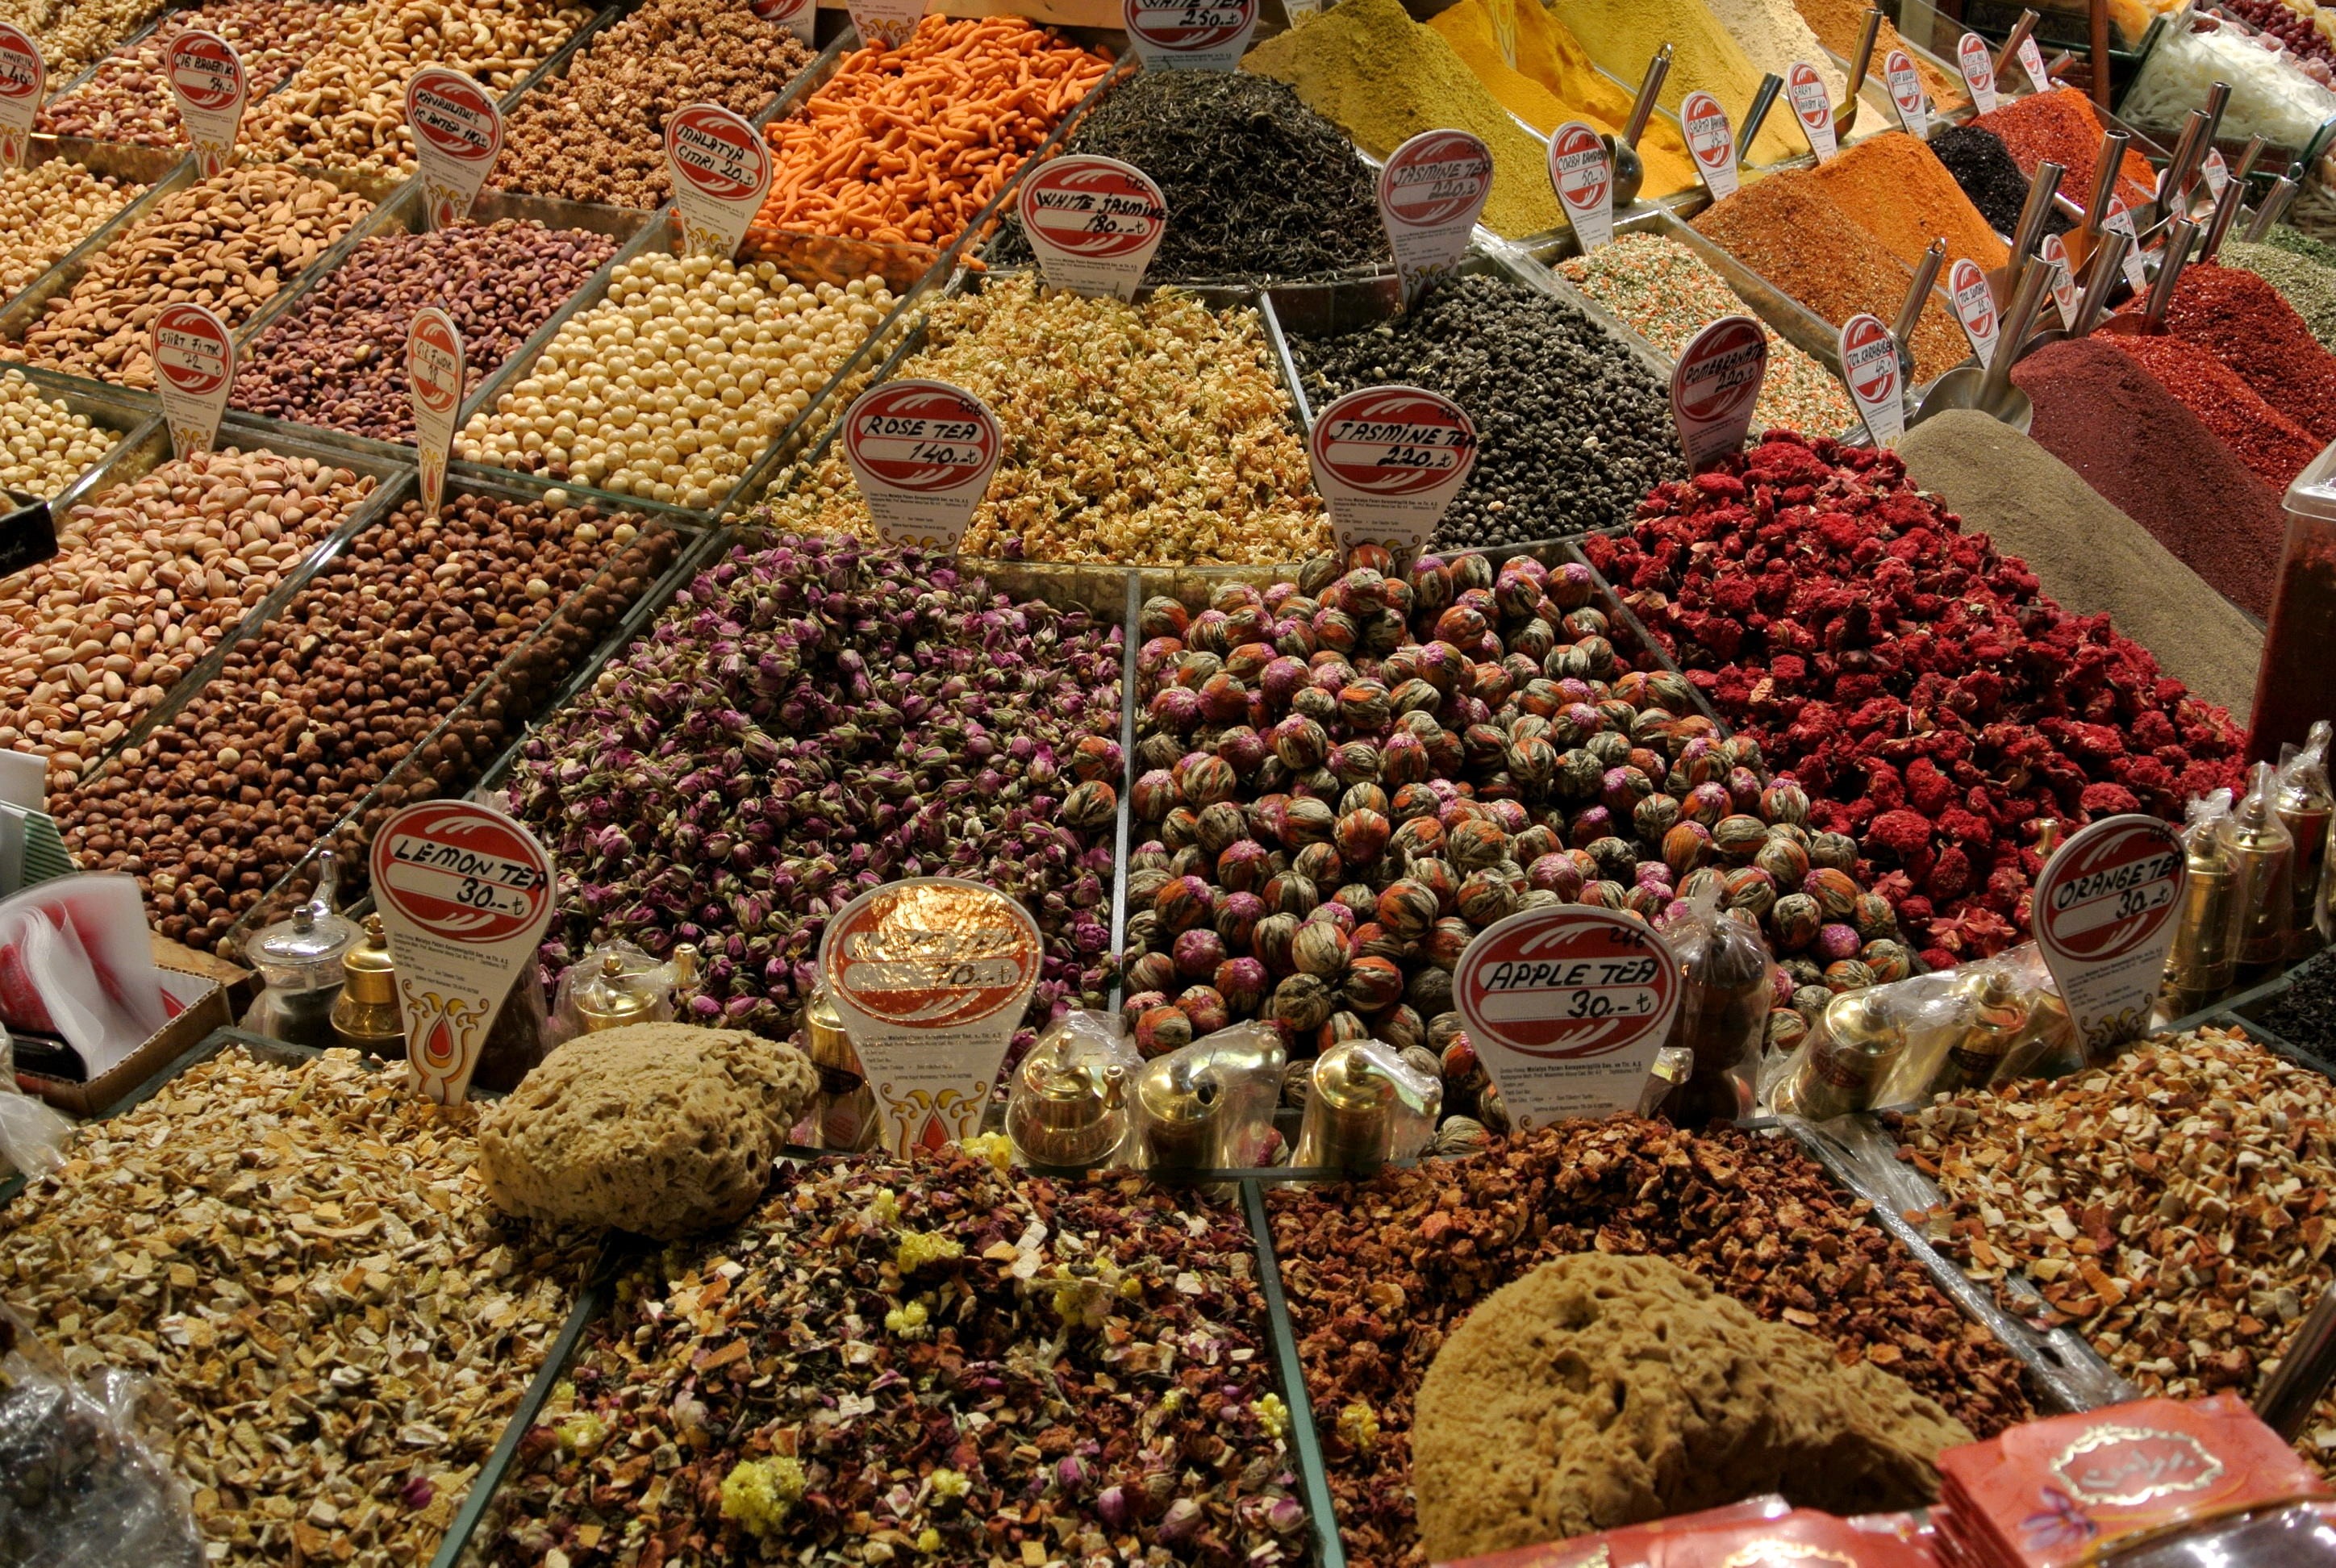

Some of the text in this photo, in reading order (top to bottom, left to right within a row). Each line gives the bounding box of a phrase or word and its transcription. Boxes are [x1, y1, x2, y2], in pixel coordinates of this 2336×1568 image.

[677, 126, 745, 161] MALATYA
[1036, 190, 1095, 211] WHITE
[864, 415, 978, 440] ROSE TEA
[1443, 430, 1477, 449] TEA
[394, 839, 549, 890] LEMON TEA
[2057, 850, 2185, 910] ORANGE TEA
[1485, 958, 1658, 991] APPLE TEA
